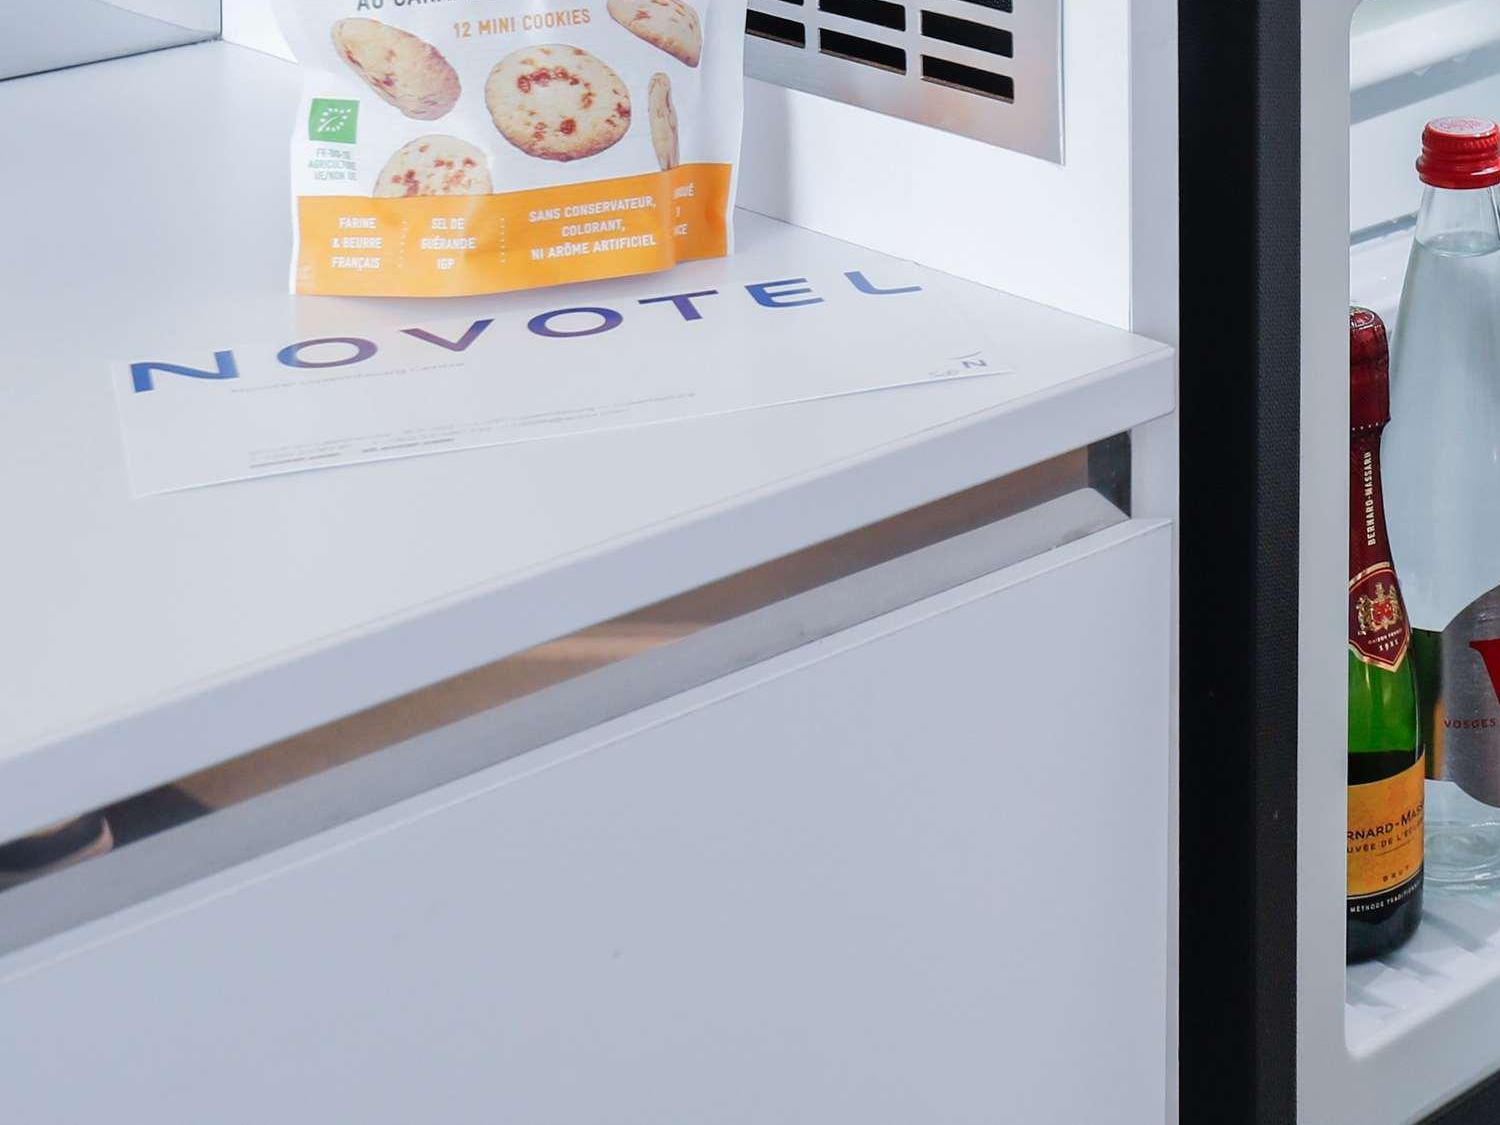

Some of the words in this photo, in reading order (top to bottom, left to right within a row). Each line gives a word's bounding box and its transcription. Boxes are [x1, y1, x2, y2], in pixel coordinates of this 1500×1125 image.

[452, 21, 471, 40] 12
[478, 16, 516, 37] MINI
[522, 9, 591, 32] COOKIES
[528, 208, 561, 223] SANS
[564, 195, 657, 218] CONSERVATEUR,
[339, 217, 377, 229] FARINE
[431, 218, 448, 229] SEL
[451, 218, 465, 229] DE
[561, 218, 626, 238] COLORANT,
[345, 236, 383, 249] BEURRE
[420, 235, 477, 250] GUÉRANDE
[531, 249, 544, 261] NI
[547, 241, 589, 259] ARÔME
[593, 234, 657, 252] ARTIFICIEL
[332, 257, 381, 271] FRANÇAIS
[129, 270, 922, 393] NOVOTEL
[1444, 717, 1496, 729] VOSGES
